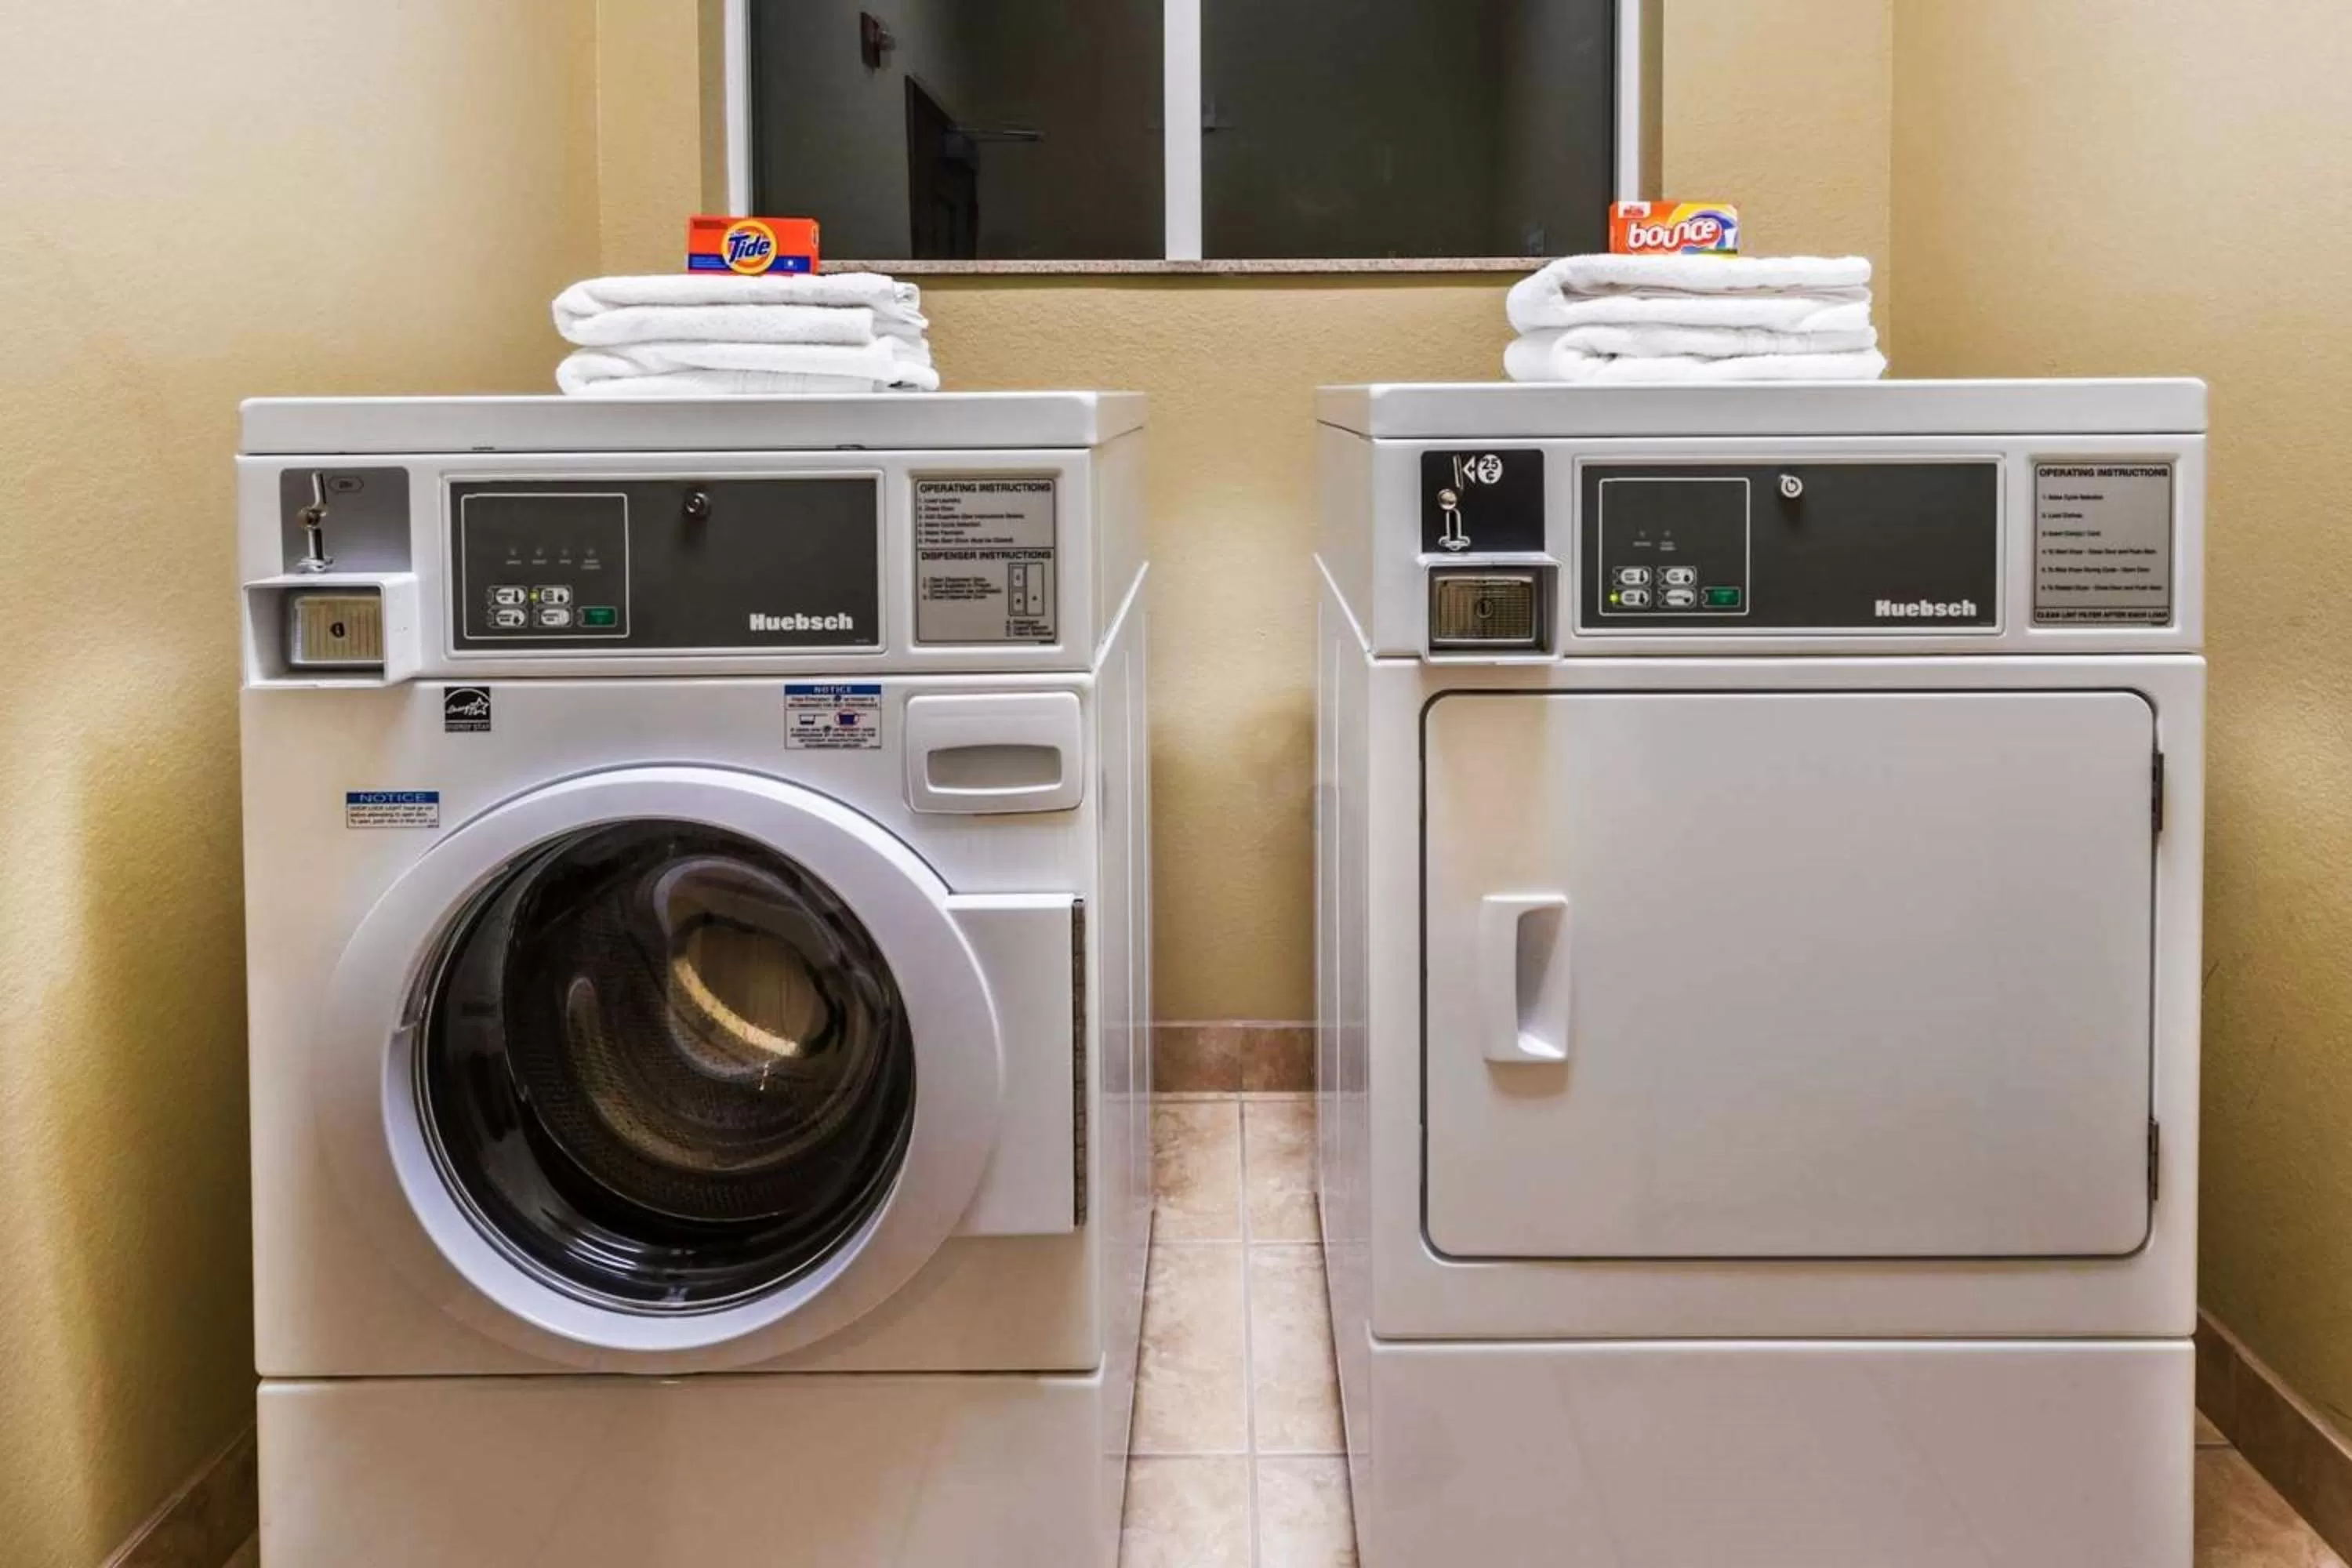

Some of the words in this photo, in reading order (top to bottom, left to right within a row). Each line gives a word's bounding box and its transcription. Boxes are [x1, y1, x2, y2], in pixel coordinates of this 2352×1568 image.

[1629, 220, 1716, 248] bounce
[728, 234, 771, 264] Tide
[1482, 458, 1498, 470] 25
[2039, 468, 2094, 477] OPERATING
[2097, 468, 2168, 477] INSTRUCTIONS
[920, 483, 976, 493] OPERATING
[979, 483, 1051, 492] INSTRUCTIONS
[921, 551, 977, 561] DISPENSER
[979, 551, 1051, 560] INSTRUCTIONS
[1875, 600, 1977, 617] Huebsch
[750, 612, 854, 630] Huebsch
[360, 793, 426, 802] NOTICE
